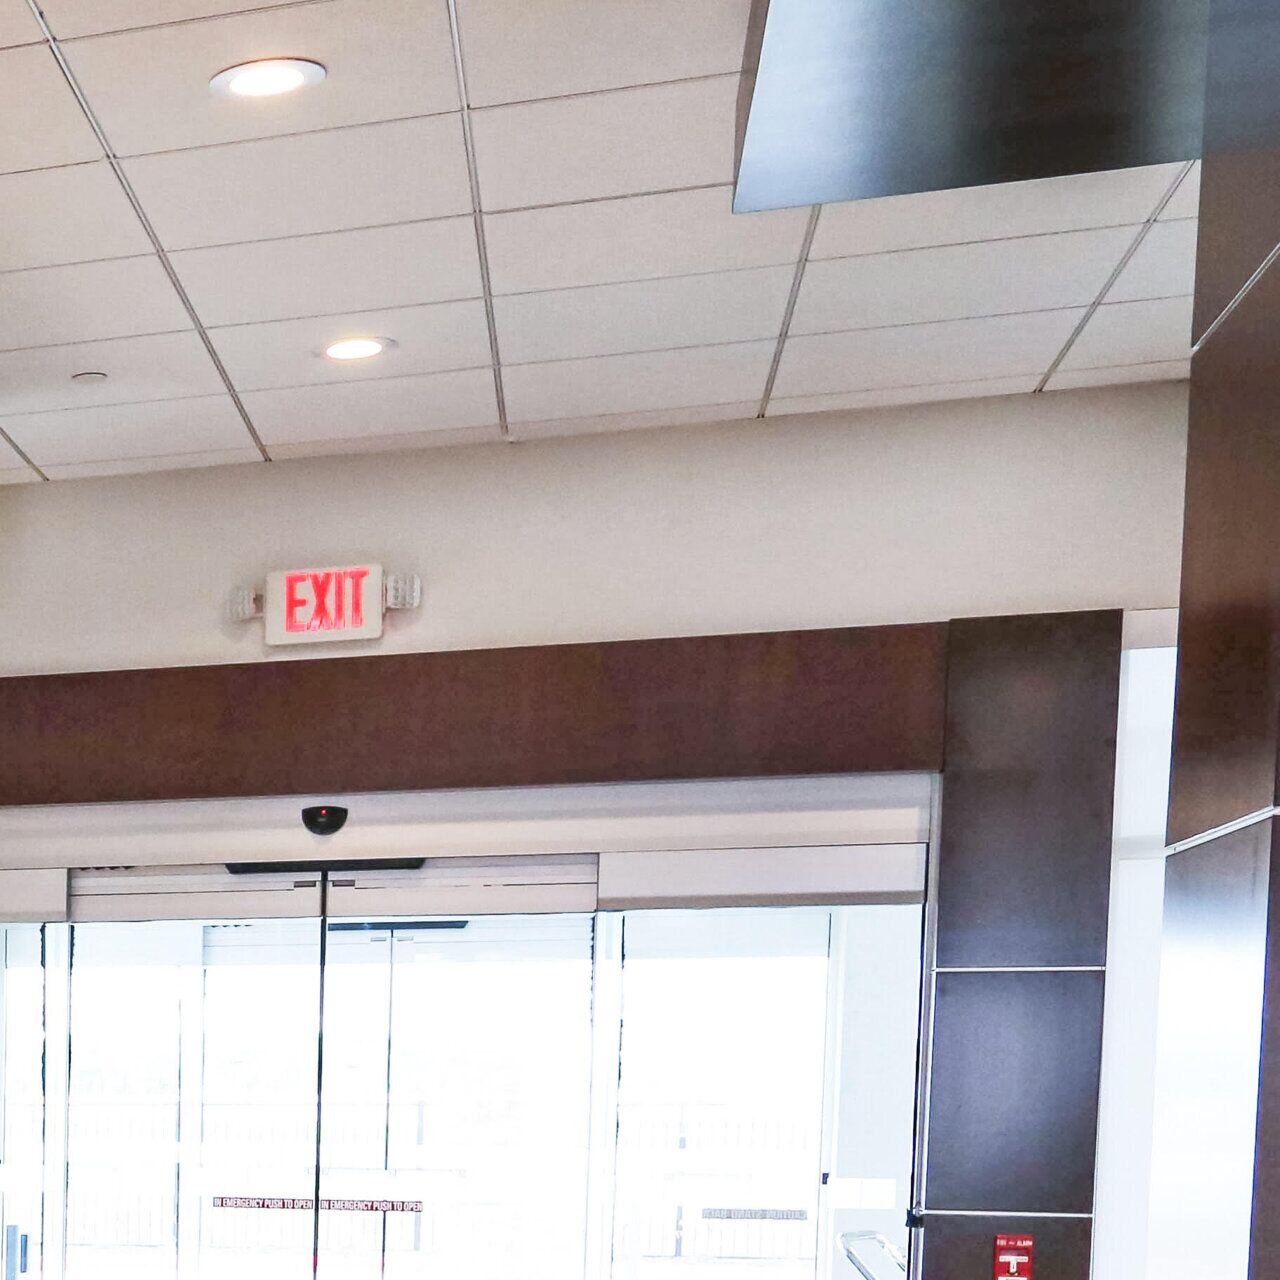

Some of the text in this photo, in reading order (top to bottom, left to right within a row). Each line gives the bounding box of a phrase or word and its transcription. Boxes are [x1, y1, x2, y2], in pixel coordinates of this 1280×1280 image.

[285, 567, 369, 632] EXIT
[214, 1198, 312, 1209] IN EMERGENCY PUSH TO OPEN
[322, 1200, 422, 1212] IN EMERGENCY PUSH TO OPEN
